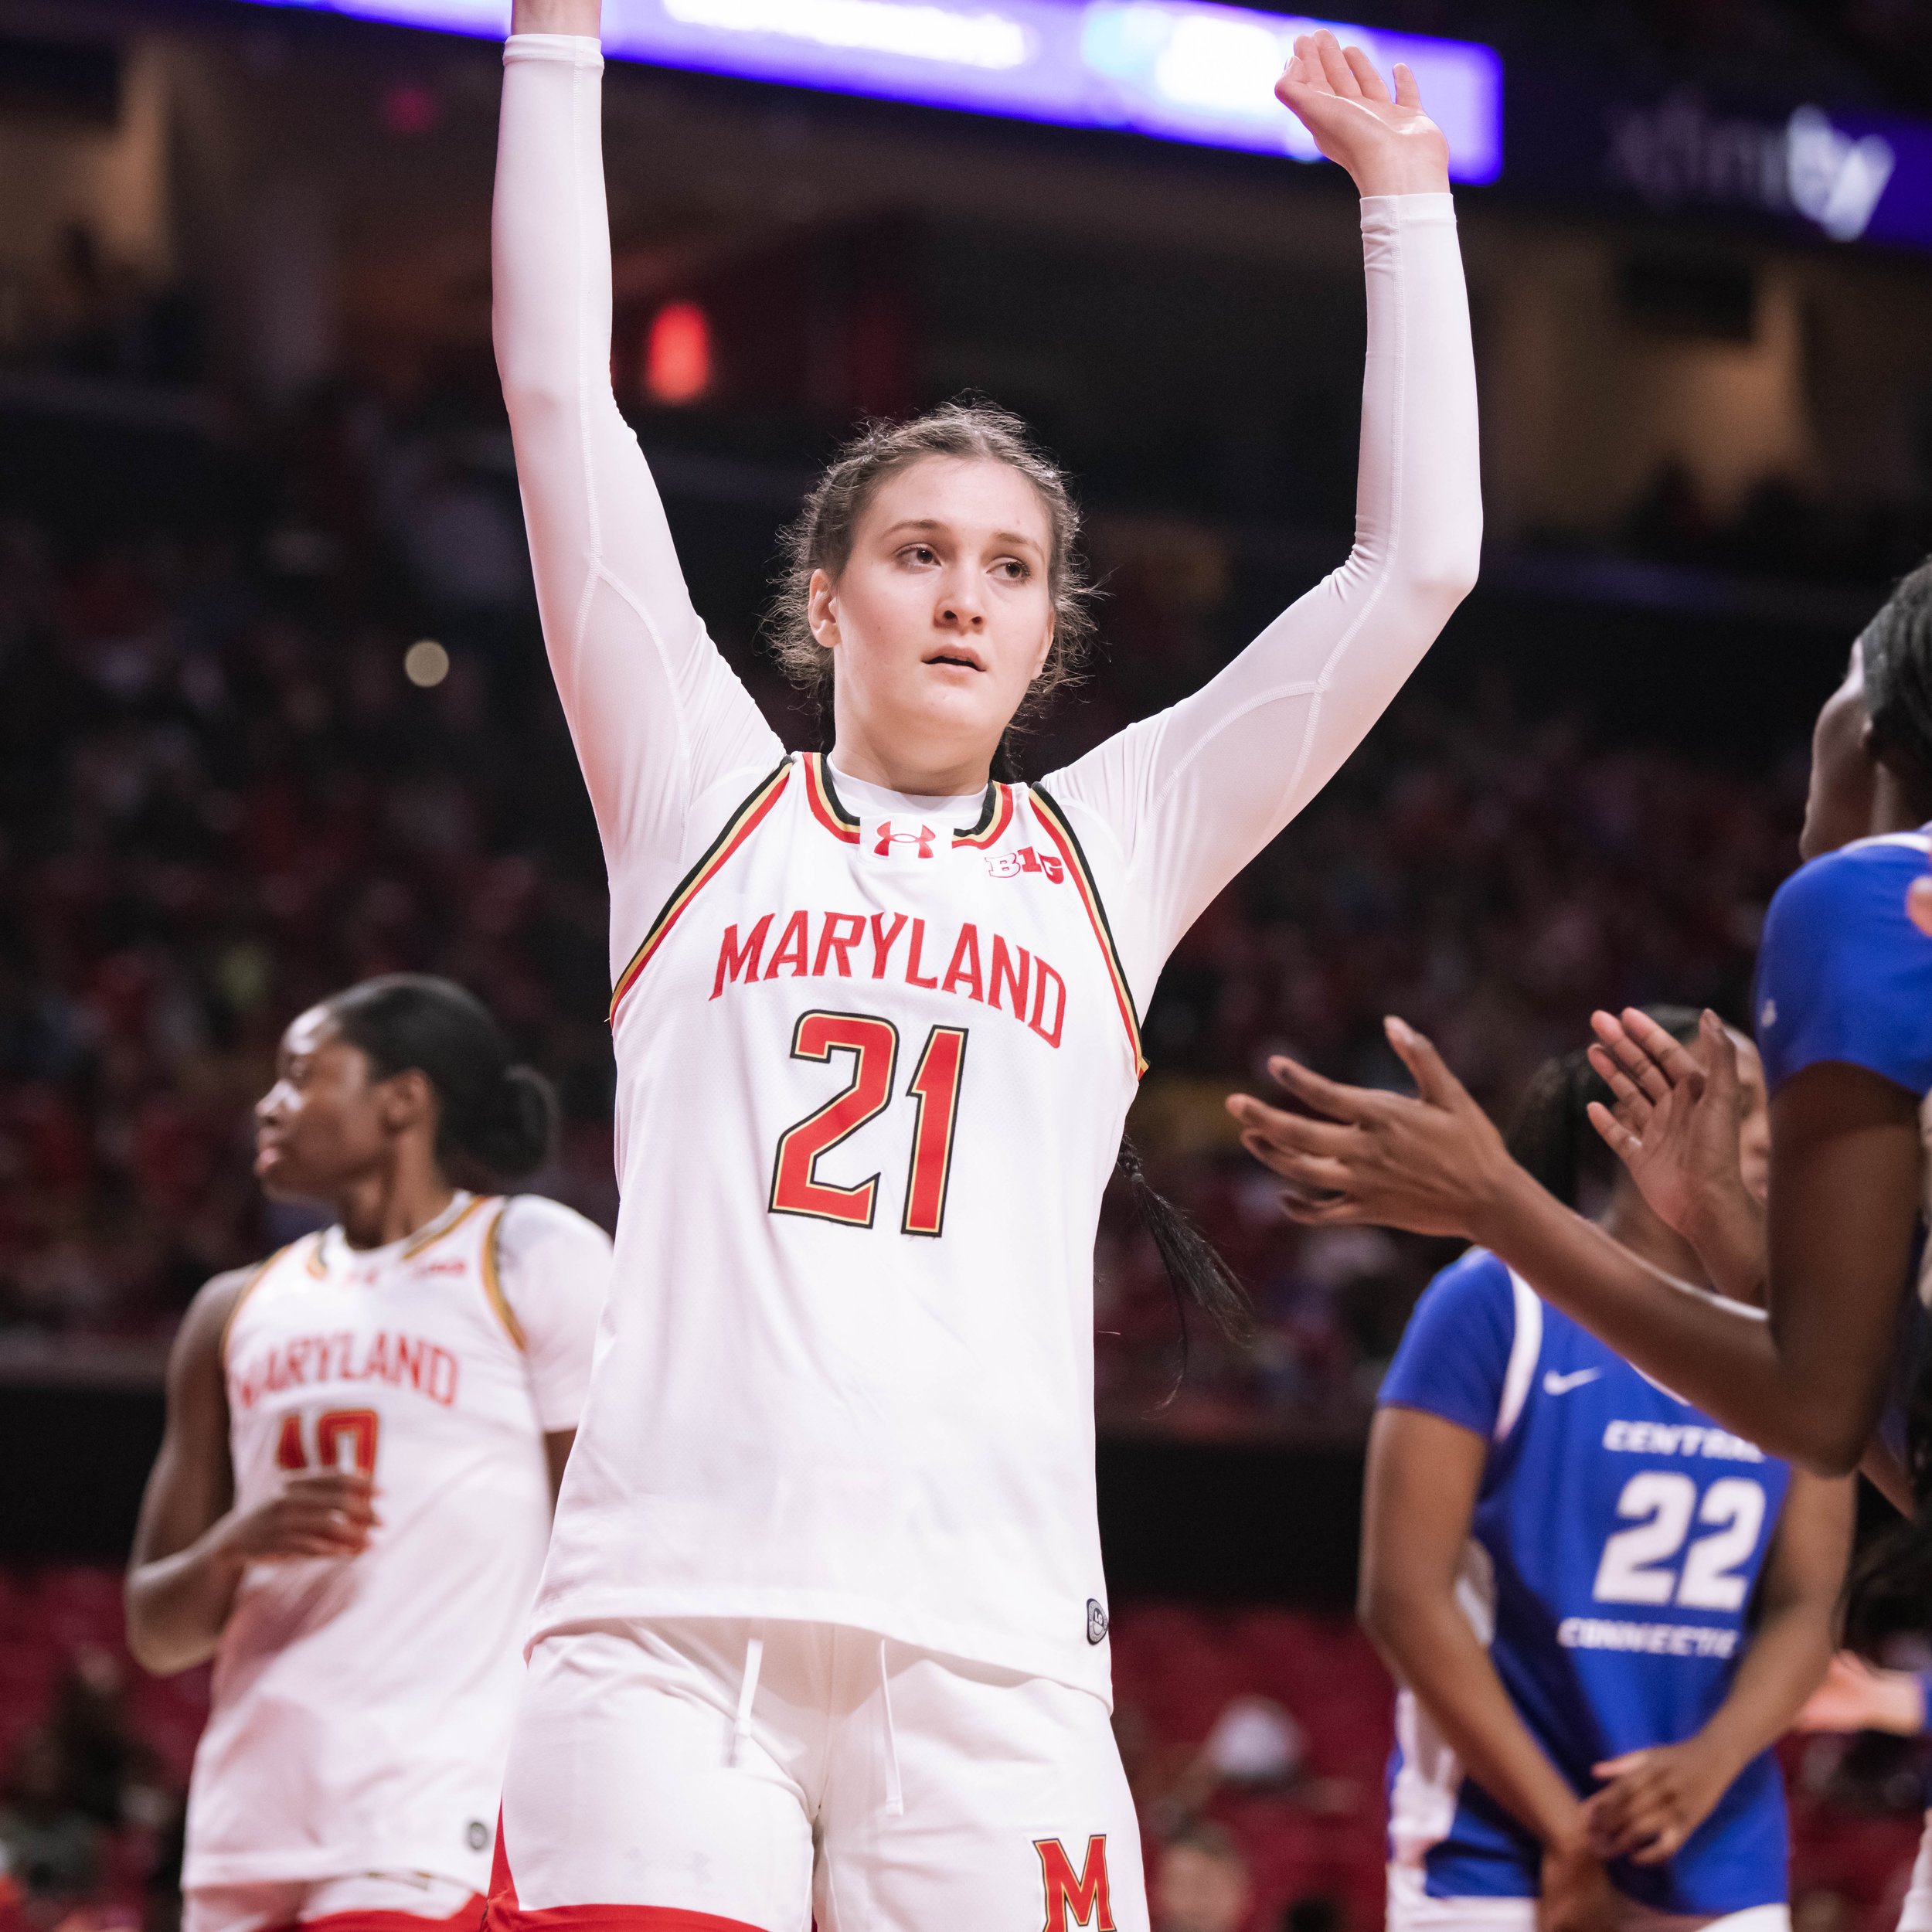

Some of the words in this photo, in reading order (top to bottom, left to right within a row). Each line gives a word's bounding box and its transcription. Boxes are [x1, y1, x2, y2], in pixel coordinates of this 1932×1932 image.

[709, 910, 1066, 1049] MARYLAND
[767, 1009, 969, 1237] 21
[235, 1331, 459, 1409] MARYLAND
[1593, 1471, 1766, 1611] 22
[1032, 1835, 1117, 1932] M
